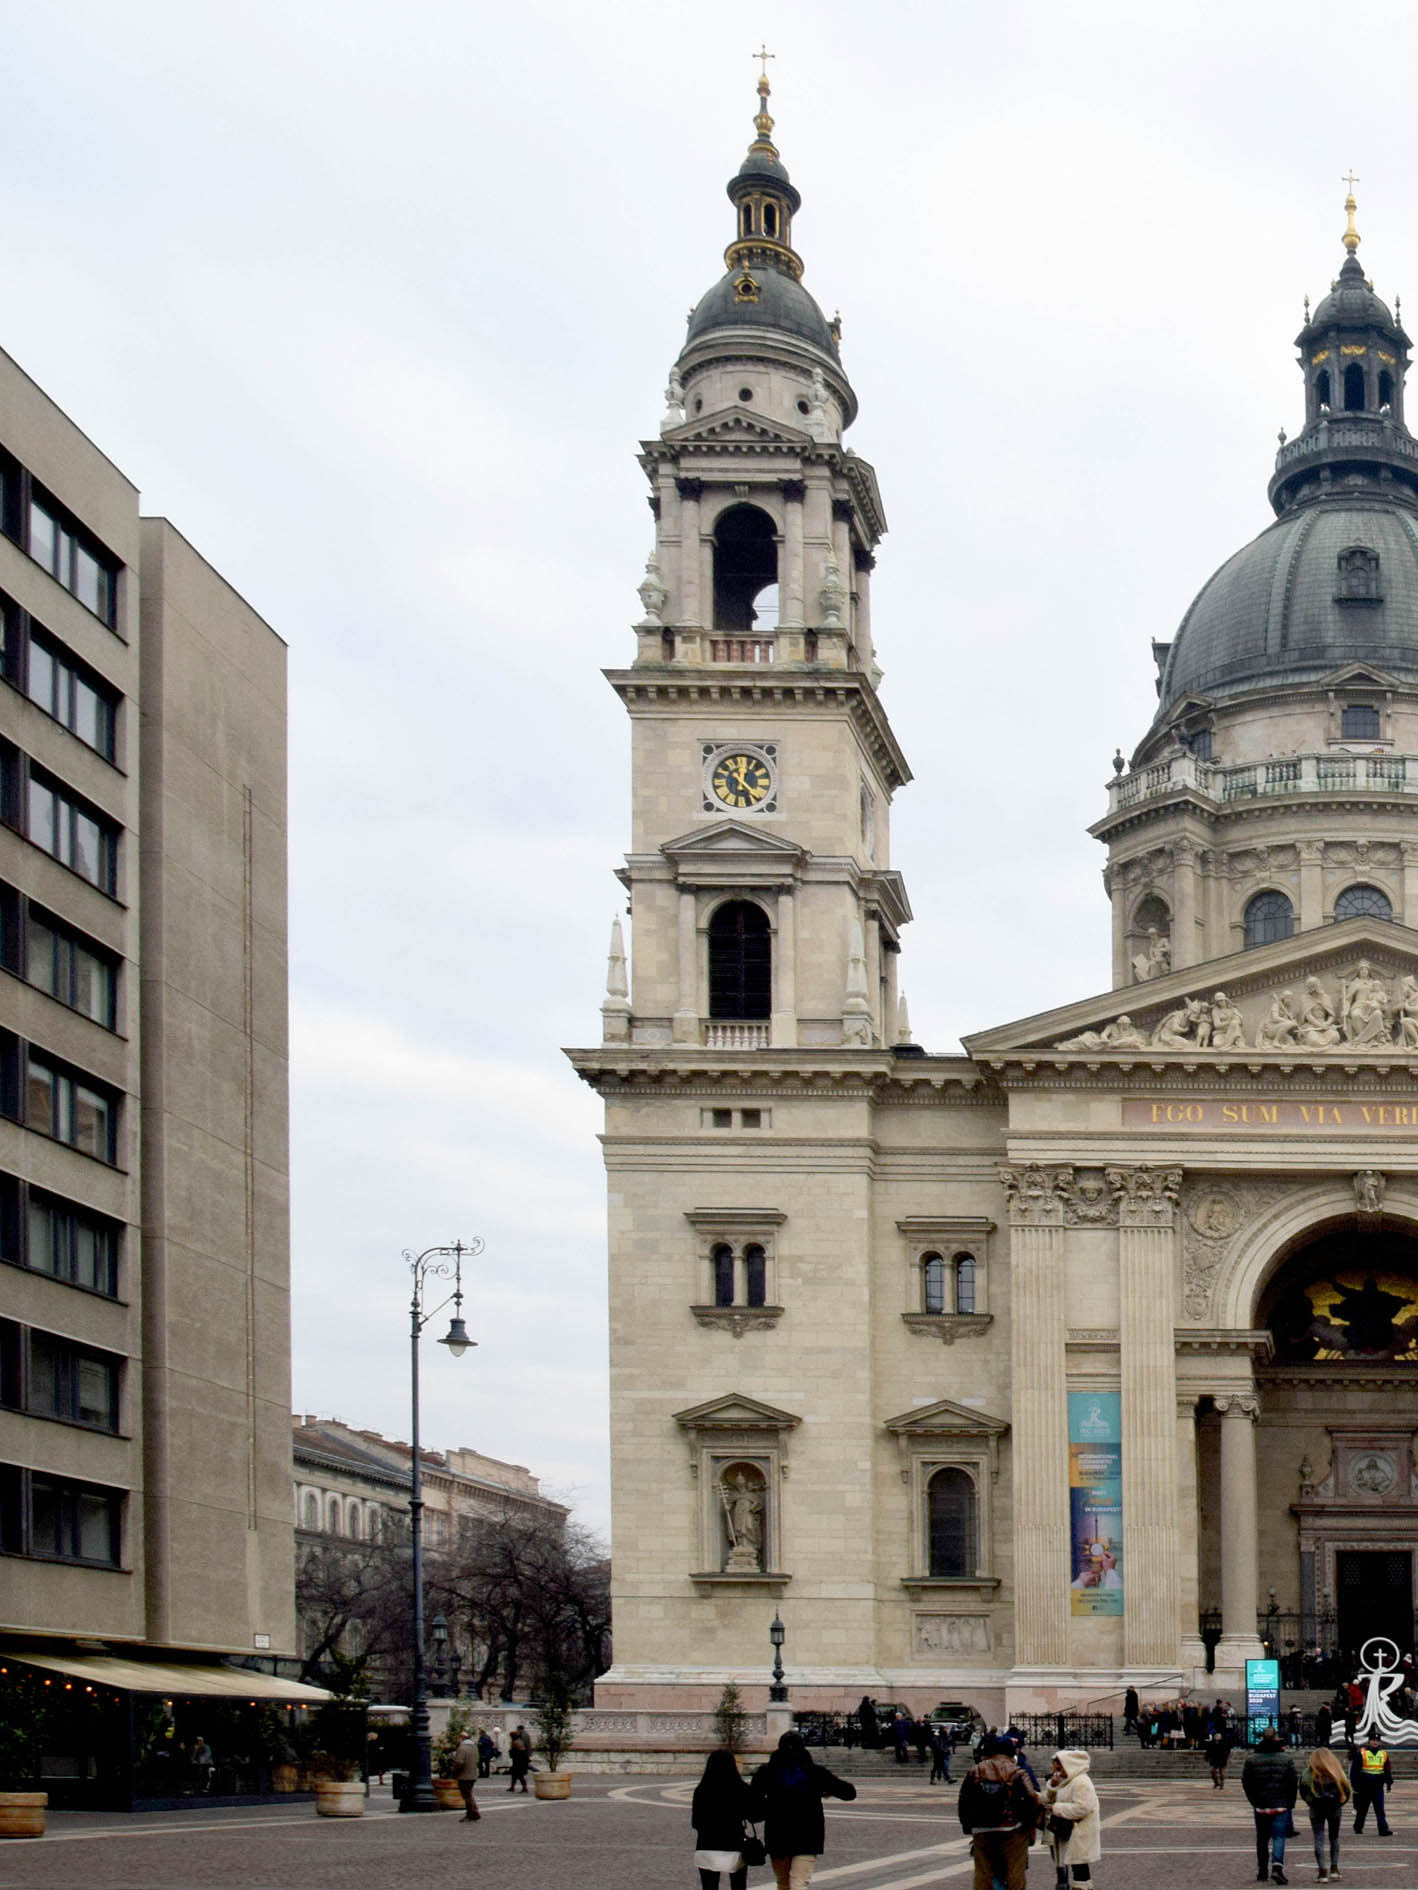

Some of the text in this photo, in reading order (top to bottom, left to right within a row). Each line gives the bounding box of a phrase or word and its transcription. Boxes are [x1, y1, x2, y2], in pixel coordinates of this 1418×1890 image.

[1151, 1104, 1204, 1123] EGO
[1222, 1105, 1280, 1124] SUM
[1300, 1105, 1344, 1125] VIA
